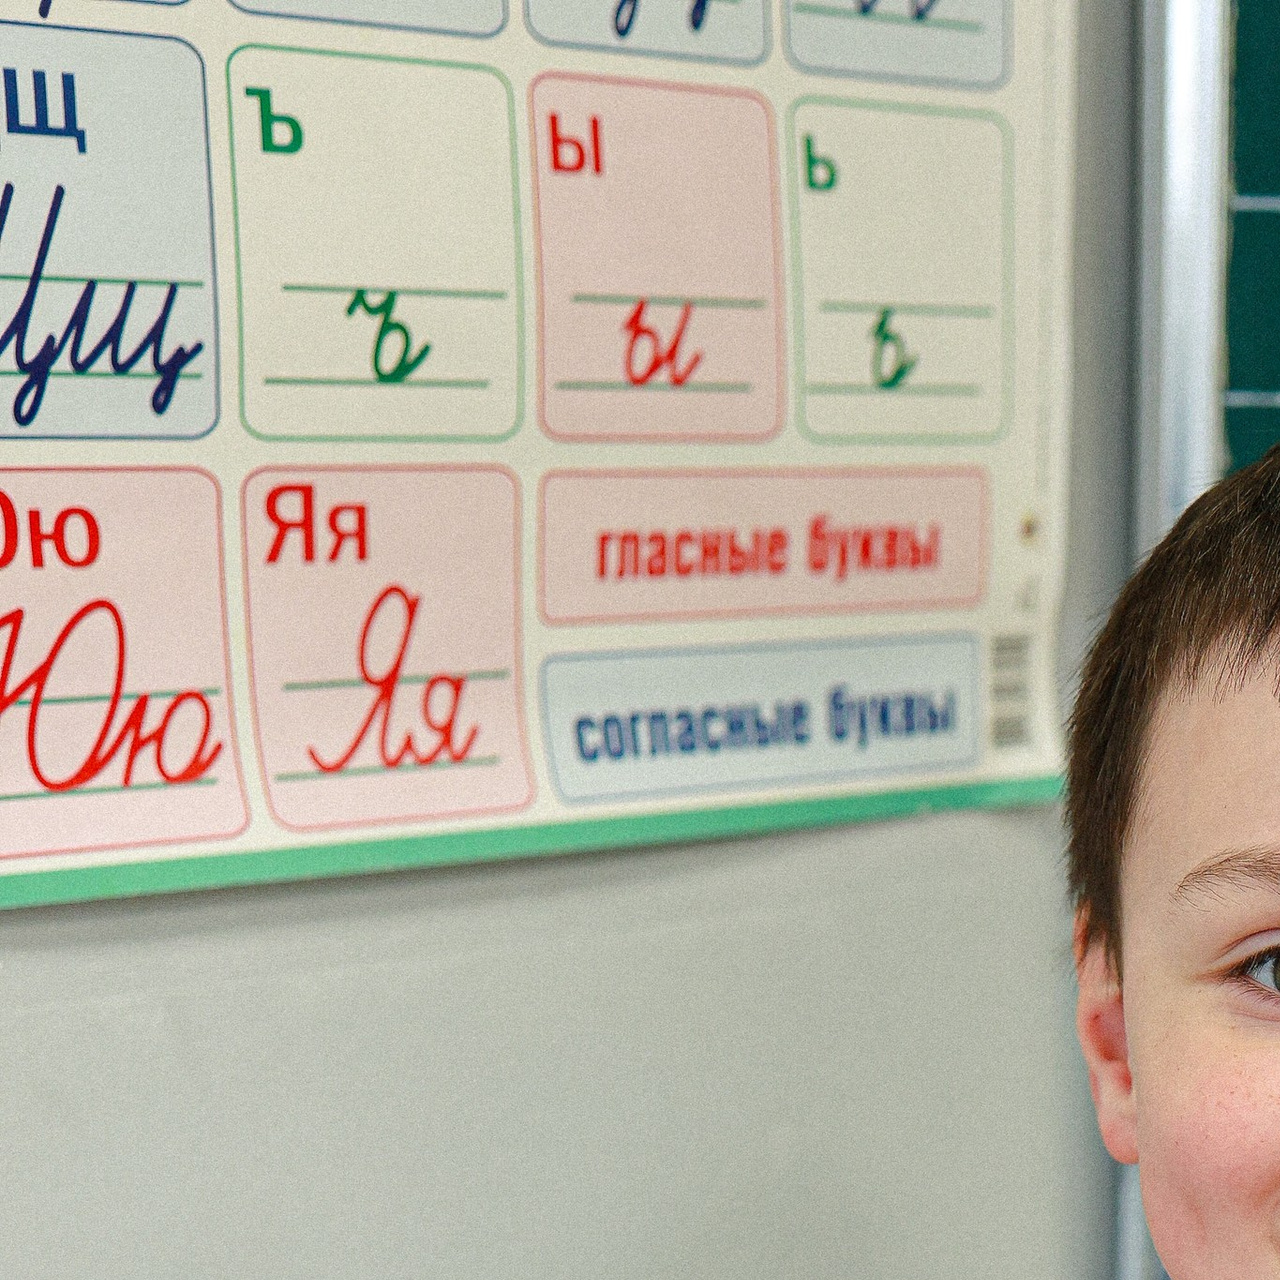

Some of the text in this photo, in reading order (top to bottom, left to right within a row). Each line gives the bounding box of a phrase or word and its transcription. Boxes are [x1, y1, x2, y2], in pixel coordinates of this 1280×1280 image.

[0, 488, 101, 569] ю
[265, 483, 368, 564] Яя
[595, 511, 943, 584] гласные буквы
[308, 586, 478, 773] Яя
[574, 682, 959, 763] согласные буквы
